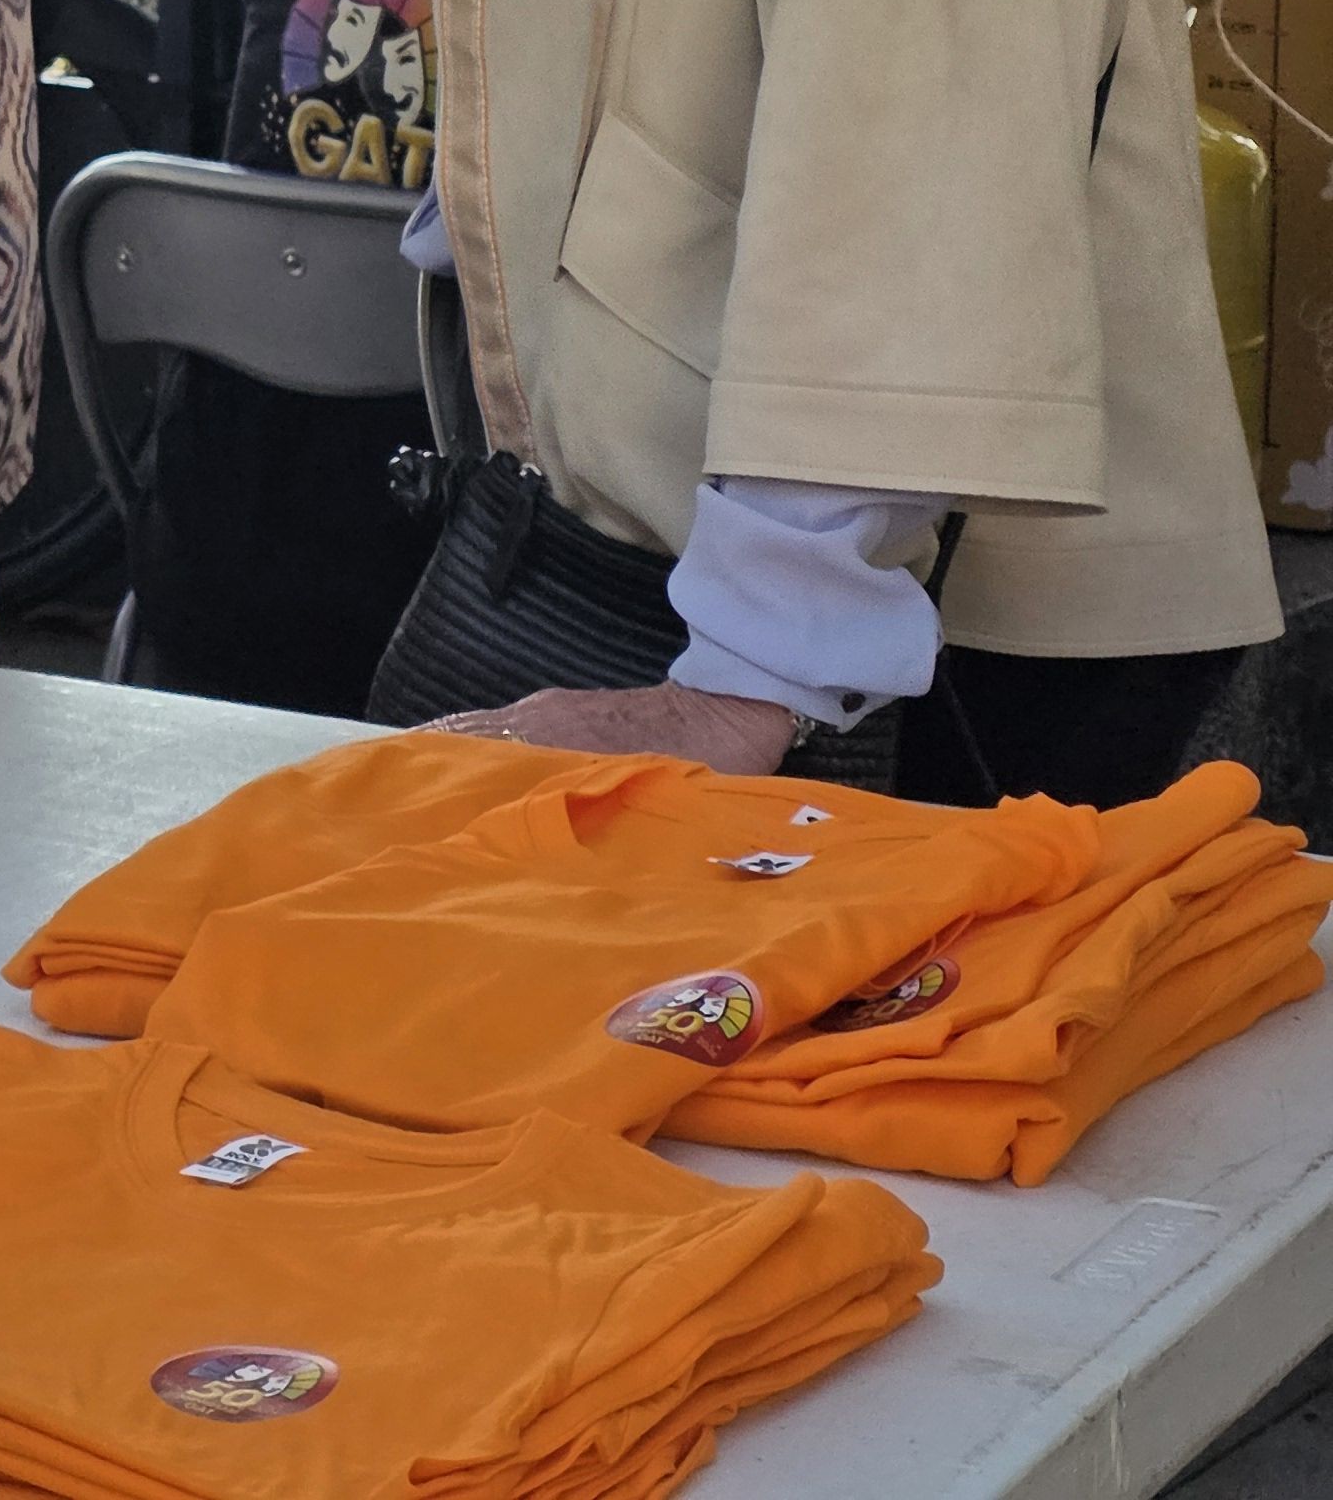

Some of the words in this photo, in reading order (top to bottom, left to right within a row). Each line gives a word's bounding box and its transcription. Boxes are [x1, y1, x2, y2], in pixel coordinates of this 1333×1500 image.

[288, 98, 435, 189] GAT
[637, 1008, 705, 1033] 50
[185, 1380, 263, 1407] 50
